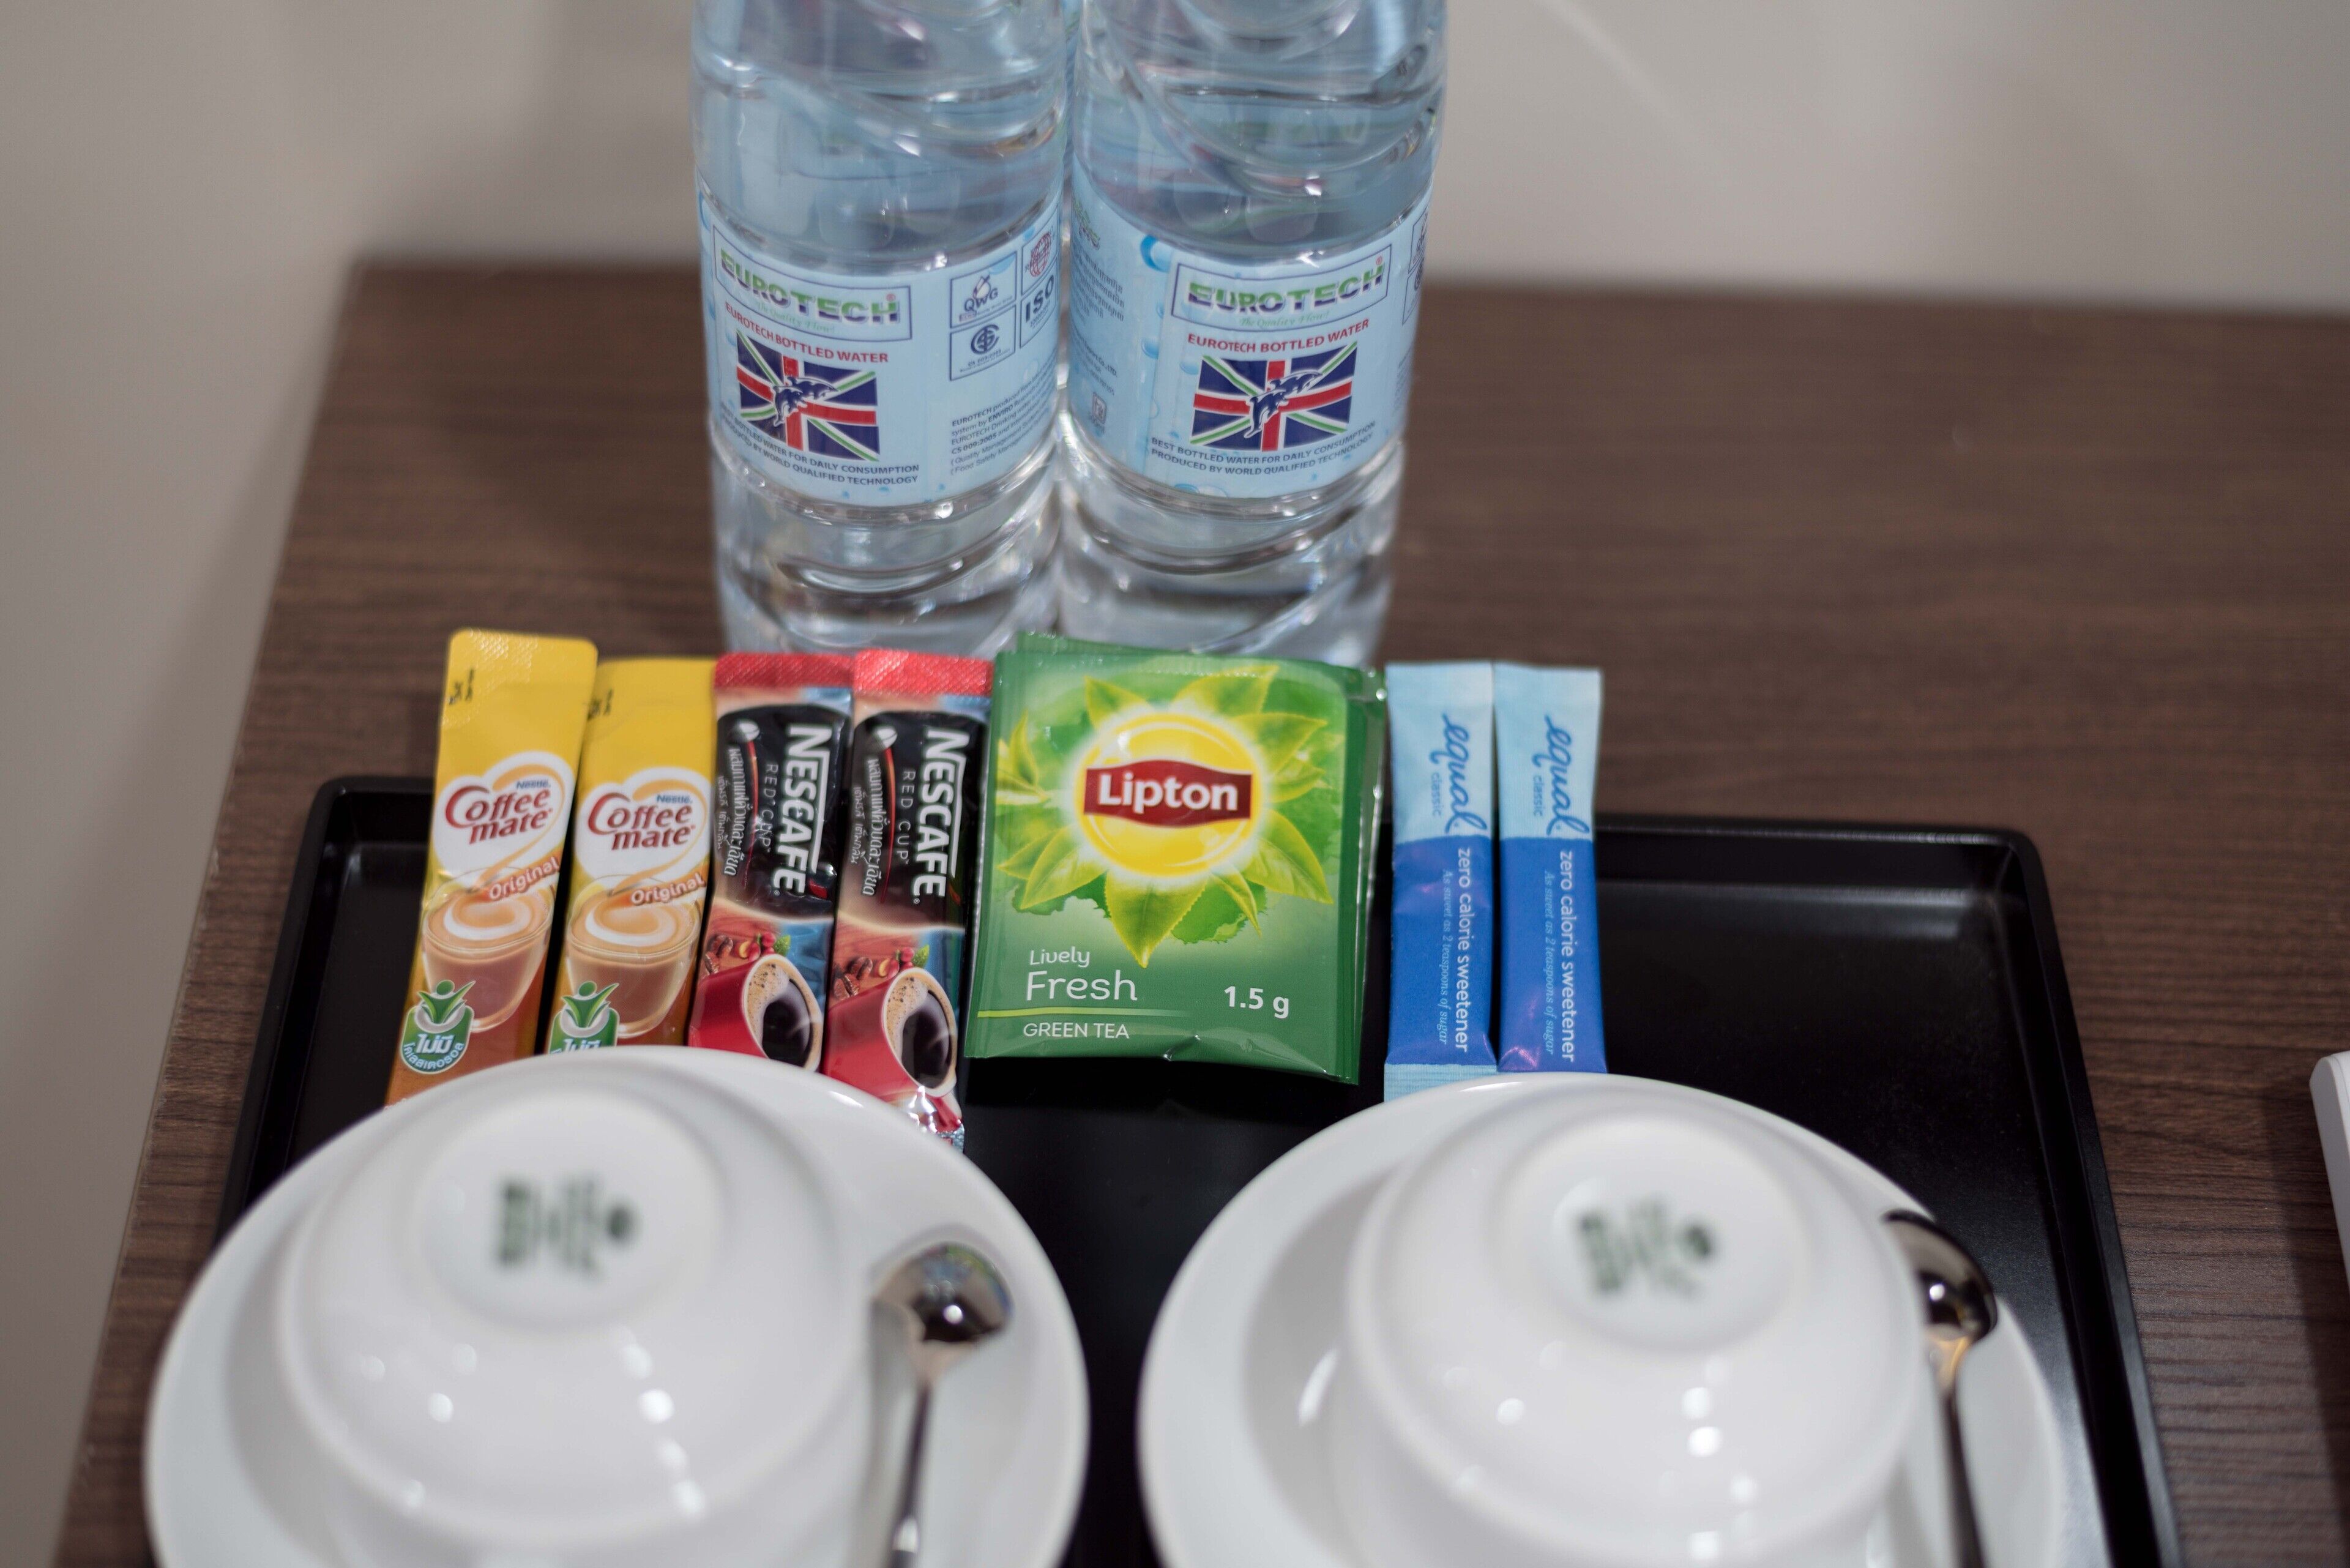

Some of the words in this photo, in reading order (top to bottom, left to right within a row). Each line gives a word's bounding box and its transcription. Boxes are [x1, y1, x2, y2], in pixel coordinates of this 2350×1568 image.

[720, 247, 900, 323] EUROTECH
[1026, 275, 1054, 323] ISO
[1188, 261, 1385, 313] EUROTECH
[726, 302, 774, 340] EUROTECH
[776, 335, 834, 360] BOTTLED
[837, 351, 889, 363] WATER
[1188, 333, 1256, 353] EUROTECH
[1260, 335, 1324, 353] BOTTLED
[1327, 318, 1370, 343] WATER
[952, 407, 991, 427] EUROTECH
[952, 426, 990, 445] EUROTECH
[763, 440, 787, 457] WATER
[789, 452, 808, 464] FOR
[810, 458, 840, 471] DAILY
[841, 464, 919, 475] CONSUMPTION
[952, 446, 962, 455] CS
[1151, 436, 1176, 452] BEST
[1177, 447, 1224, 463] BOTTLED
[1226, 456, 1260, 465] WATER
[1261, 455, 1280, 465] FOR
[1282, 449, 1311, 462] DAILY
[1313, 420, 1376, 455] CONSUMPTION
[1151, 448, 1207, 471] PRODUCED
[1209, 465, 1223, 474] BY
[1225, 466, 1261, 476] WORLD
[1263, 460, 1316, 476] QUALIFIED
[1318, 432, 1374, 464] TECHNOLOGY
[764, 450, 791, 469] WORLD
[793, 463, 845, 483] QUALIFIED
[847, 474, 919, 485] TECHNOLOGY
[764, 763, 779, 799] RED
[900, 768, 916, 809] RED
[1097, 773, 1238, 814] Lipton
[1430, 712, 1487, 834] equal
[1532, 714, 1589, 836] equal
[445, 785, 551, 829] Coffee
[588, 792, 693, 835] Coffee
[1533, 774, 1545, 817] classic
[469, 810, 548, 845] mate
[611, 826, 691, 851] mate
[759, 808, 774, 848] CUP
[896, 821, 911, 861] CUP
[490, 856, 560, 902] Original
[1458, 847, 1471, 888] zero
[1560, 850, 1572, 891] zero
[630, 872, 707, 906] Original
[1458, 893, 1475, 950] calorie
[1561, 895, 1577, 957] calorie
[1029, 946, 1091, 968] Lively
[1439, 944, 1451, 996] teaspoons
[1543, 947, 1555, 1004] teaspoons
[1026, 969, 1138, 1001] Fresh
[1224, 985, 1265, 1010] 1.5
[1273, 996, 1290, 1020] g
[1438, 998, 1452, 1010] of
[1455, 955, 1471, 1053] sweetener
[1023, 1021, 1089, 1038] GREEN
[1093, 1023, 1130, 1039] TEA
[1437, 1012, 1448, 1045] sugar
[1544, 1006, 1556, 1019] of
[1561, 961, 1577, 1063] sweetener
[416, 1032, 455, 1055] ไม่มี
[1543, 1020, 1554, 1055] sugar
